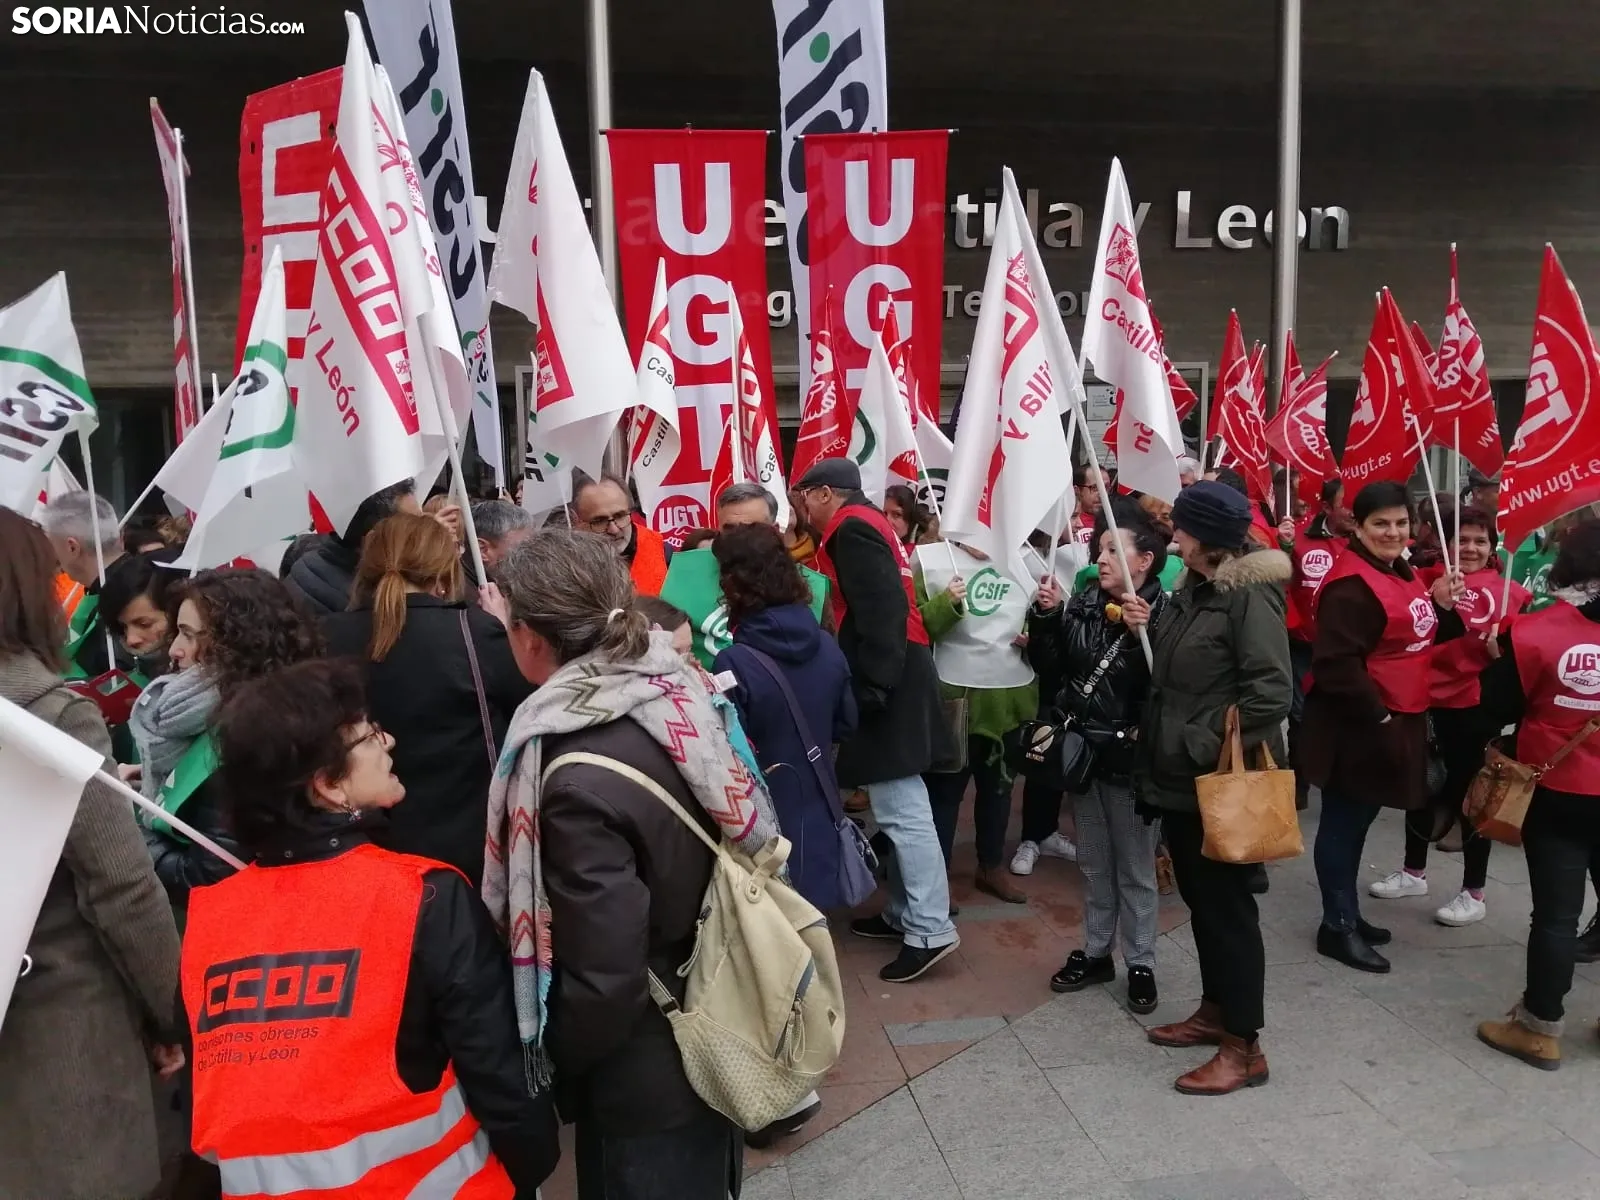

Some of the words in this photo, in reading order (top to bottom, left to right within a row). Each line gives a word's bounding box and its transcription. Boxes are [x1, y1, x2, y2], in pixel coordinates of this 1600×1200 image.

[844, 159, 914, 390] UG
[654, 162, 736, 472] UGT
[315, 337, 360, 437] León
[642, 417, 670, 468] Castill
[658, 504, 701, 533] UGT
[1306, 554, 1330, 566] UGT
[975, 582, 1011, 601] CSIF
[1565, 652, 1600, 673] UG
[206, 964, 347, 1017] CCOO
[259, 1026, 320, 1042] obreras
[248, 1050, 257, 1066] y
[259, 1045, 300, 1061] León
